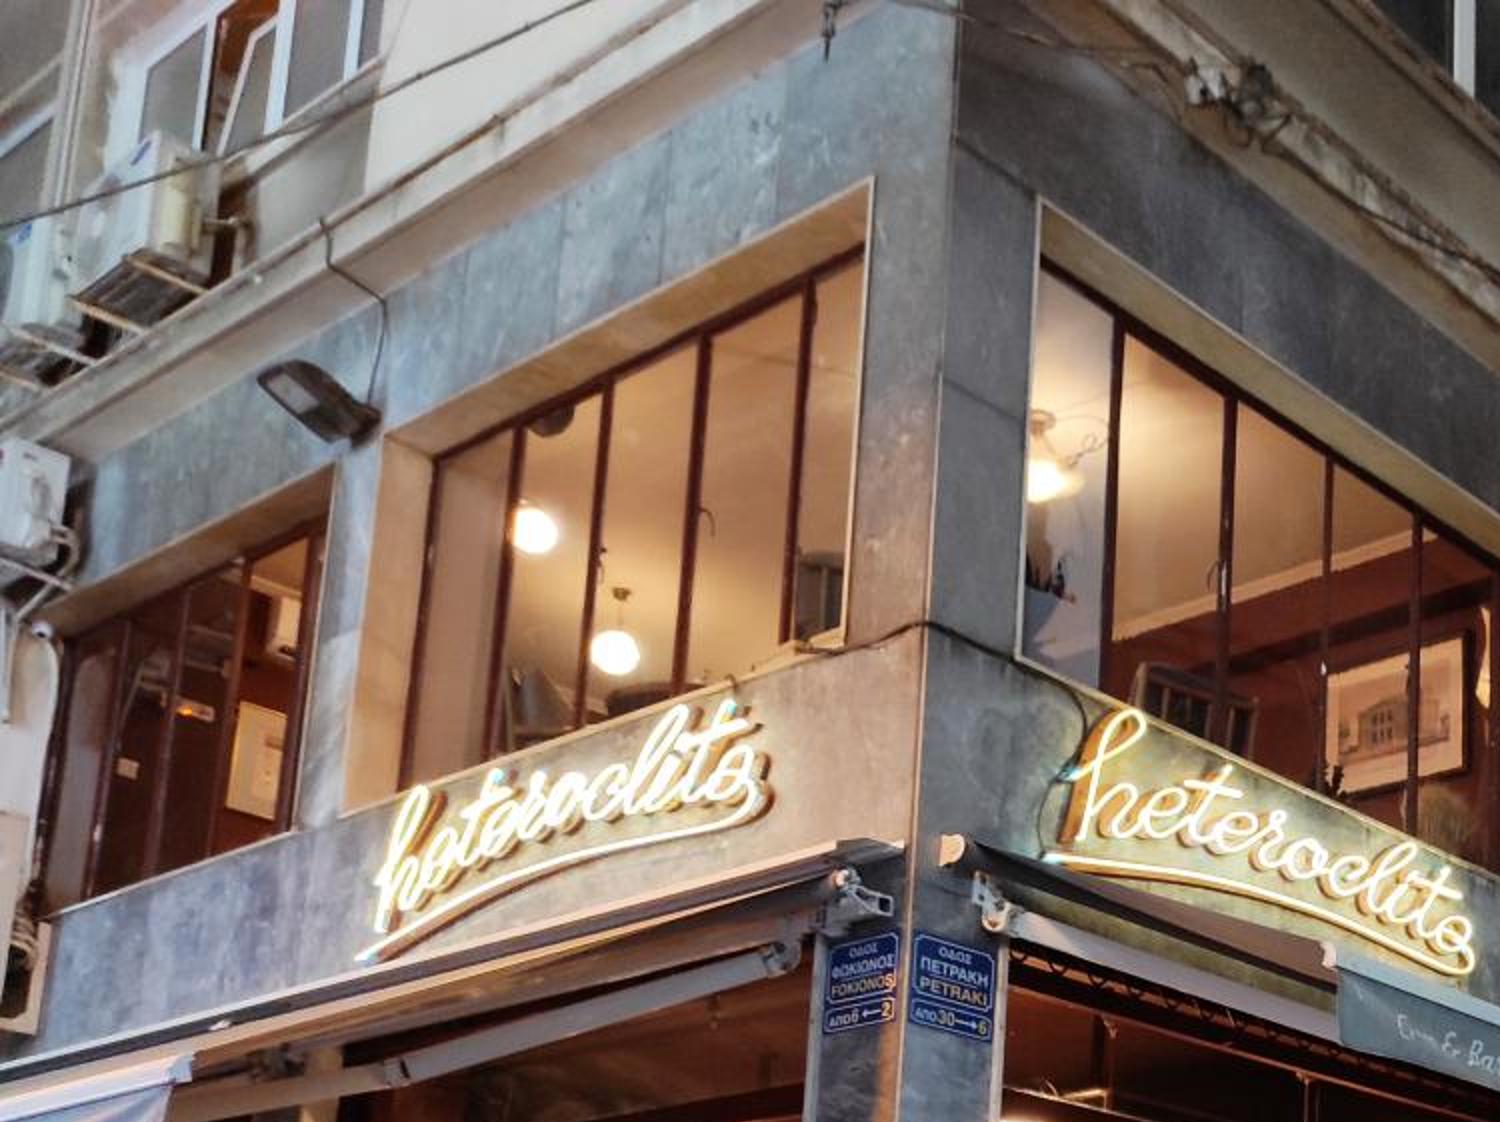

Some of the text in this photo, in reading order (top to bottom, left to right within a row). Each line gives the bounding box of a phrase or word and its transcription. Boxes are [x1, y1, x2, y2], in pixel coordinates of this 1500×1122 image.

[365, 697, 759, 945] heteroclito
[1060, 708, 1475, 970] heteroclito
[849, 942, 878, 958] ΟΔΟΣ
[938, 946, 973, 965] ΟΔΟΣ
[831, 973, 894, 998] FOKIONOS
[920, 957, 989, 988] ΠΕΤΡΑΚΗ
[920, 976, 988, 1006] PETRAKI
[881, 1003, 891, 1018] 2
[938, 1009, 956, 1027] 30
[977, 1021, 987, 1035] 6
